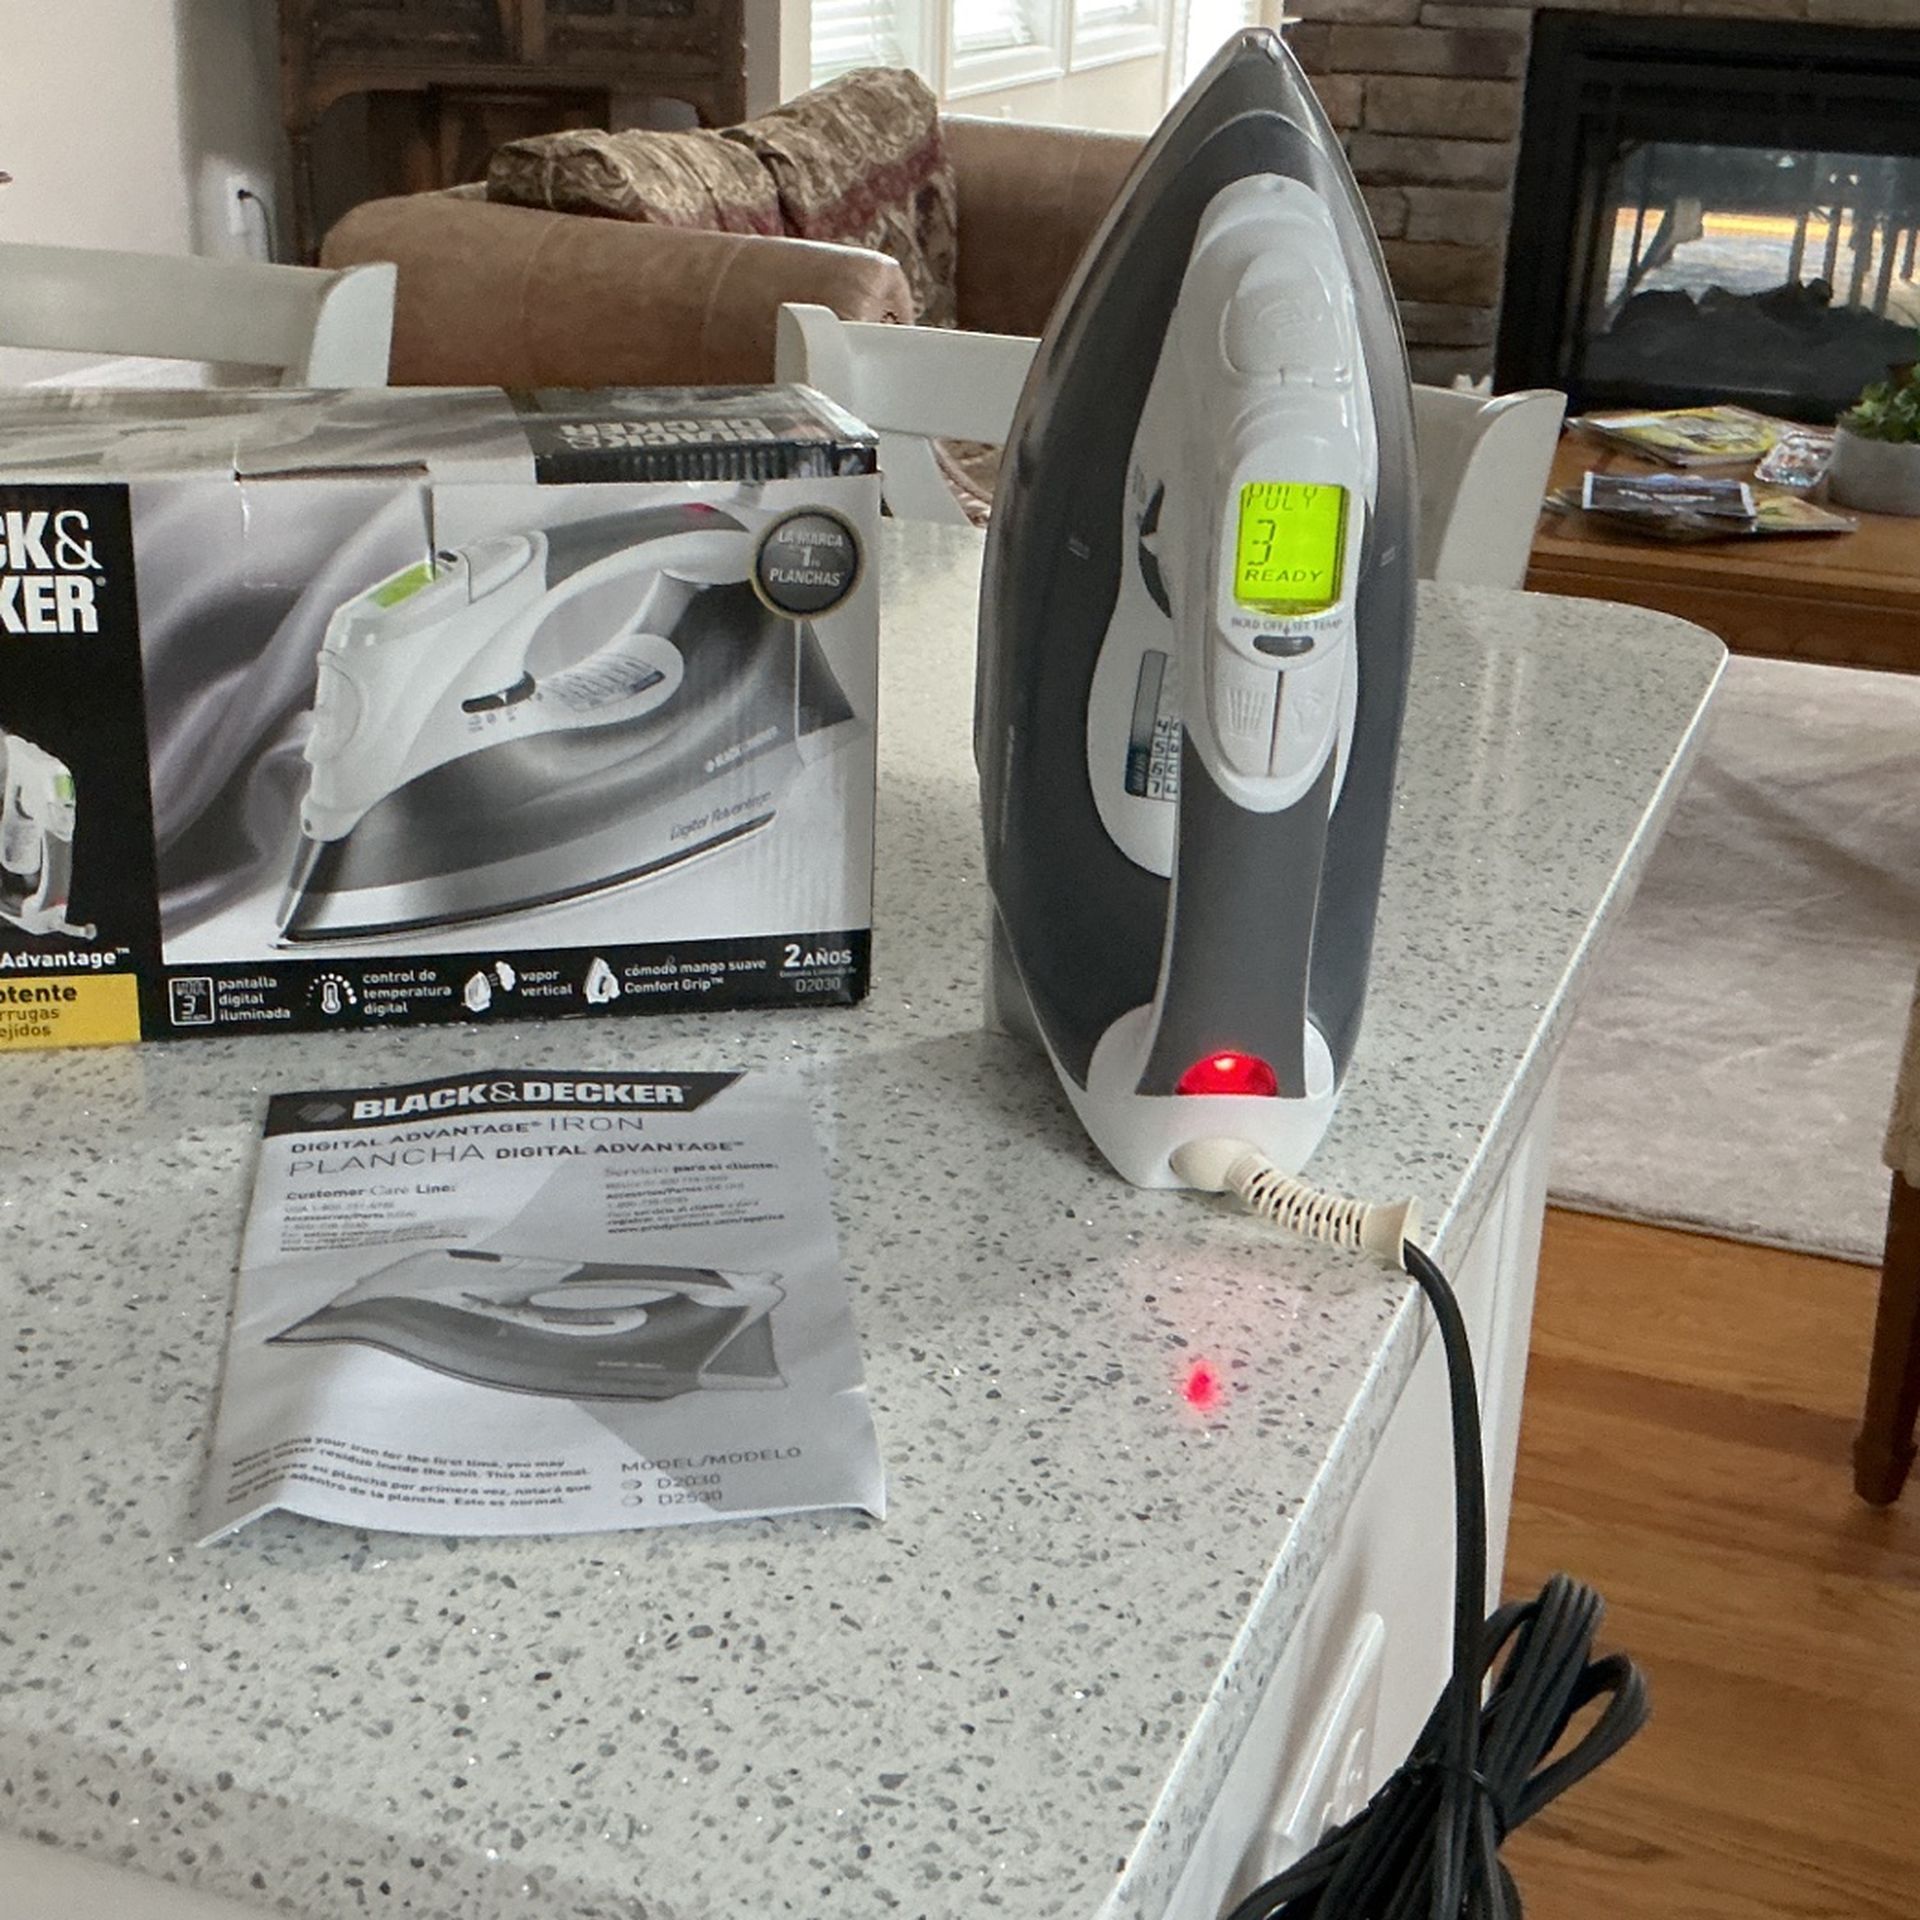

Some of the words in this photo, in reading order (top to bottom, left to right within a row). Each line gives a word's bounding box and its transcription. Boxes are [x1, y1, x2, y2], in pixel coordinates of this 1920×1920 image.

[1246, 484, 1318, 511] POLY
[0, 510, 103, 570] K&
[1248, 519, 1276, 566] 3
[769, 567, 841, 587] PLANCHAS
[1244, 569, 1323, 582] READY
[784, 944, 801, 968] 2
[803, 948, 853, 966] AÑOS
[680, 962, 726, 976] mango
[728, 959, 767, 970] suave
[217, 976, 278, 991] pantalla
[362, 970, 415, 983] control
[419, 969, 436, 981] de
[521, 969, 560, 983] vapor
[363, 985, 452, 1000] temperatura
[521, 982, 573, 997] vertical
[624, 980, 680, 994] Comfort
[219, 993, 264, 1008] digital
[220, 1007, 291, 1021] iluminada
[364, 1001, 408, 1016] digital
[291, 1138, 383, 1153] DIGITAL
[551, 1116, 644, 1132] IRON
[288, 1143, 485, 1177] PLANCHA
[496, 1144, 587, 1160] DIGITAL
[287, 1187, 365, 1200] Customer
[416, 1183, 456, 1194] Line:
[315, 1437, 347, 1449] your
[351, 1444, 379, 1456] iron
[383, 1448, 402, 1459] for
[407, 1453, 429, 1464] the
[433, 1455, 462, 1467] first
[535, 1459, 565, 1469] may
[621, 1446, 802, 1473] MODEL/MODELO
[376, 1460, 419, 1474] inside
[423, 1465, 450, 1476] the
[486, 1469, 515, 1479] This
[391, 1482, 415, 1492] por
[419, 1484, 479, 1496] primera
[657, 1474, 721, 1489] D2030
[349, 1485, 366, 1496] de
[658, 1490, 723, 1505] D2530
